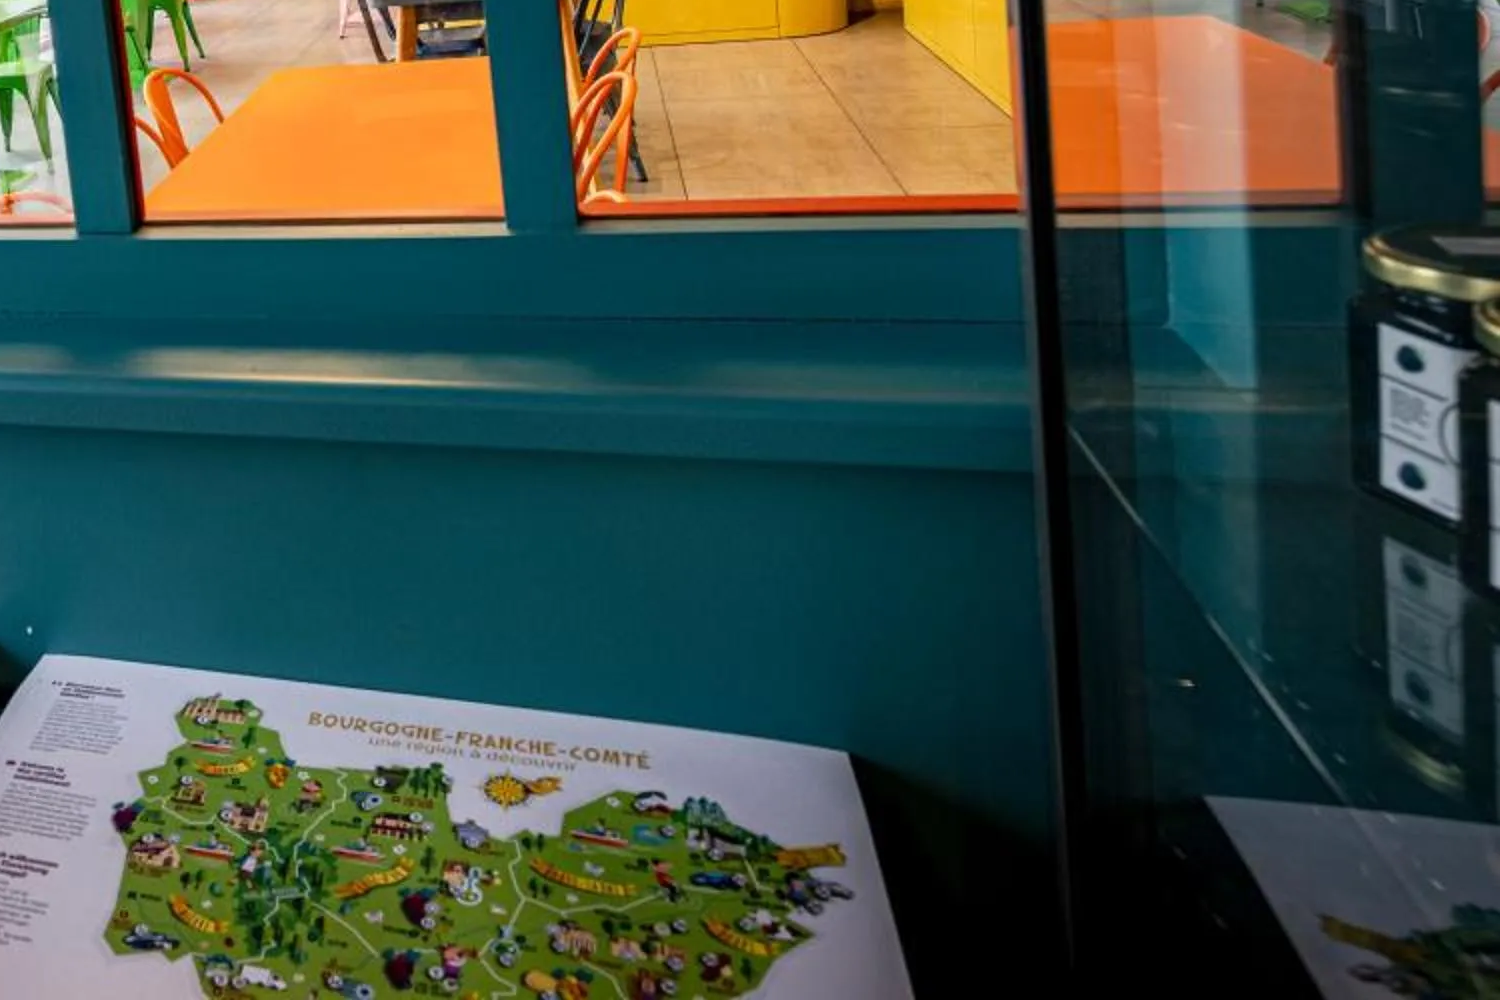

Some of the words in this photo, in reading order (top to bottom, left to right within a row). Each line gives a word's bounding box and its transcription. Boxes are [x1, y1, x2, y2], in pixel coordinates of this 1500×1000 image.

[308, 711, 652, 770] BOURGOGNE-FRANCHE-COMTÉ
[368, 738, 402, 750] une
[406, 739, 465, 757] région
[469, 748, 482, 761] à
[486, 750, 578, 771] découvrir
